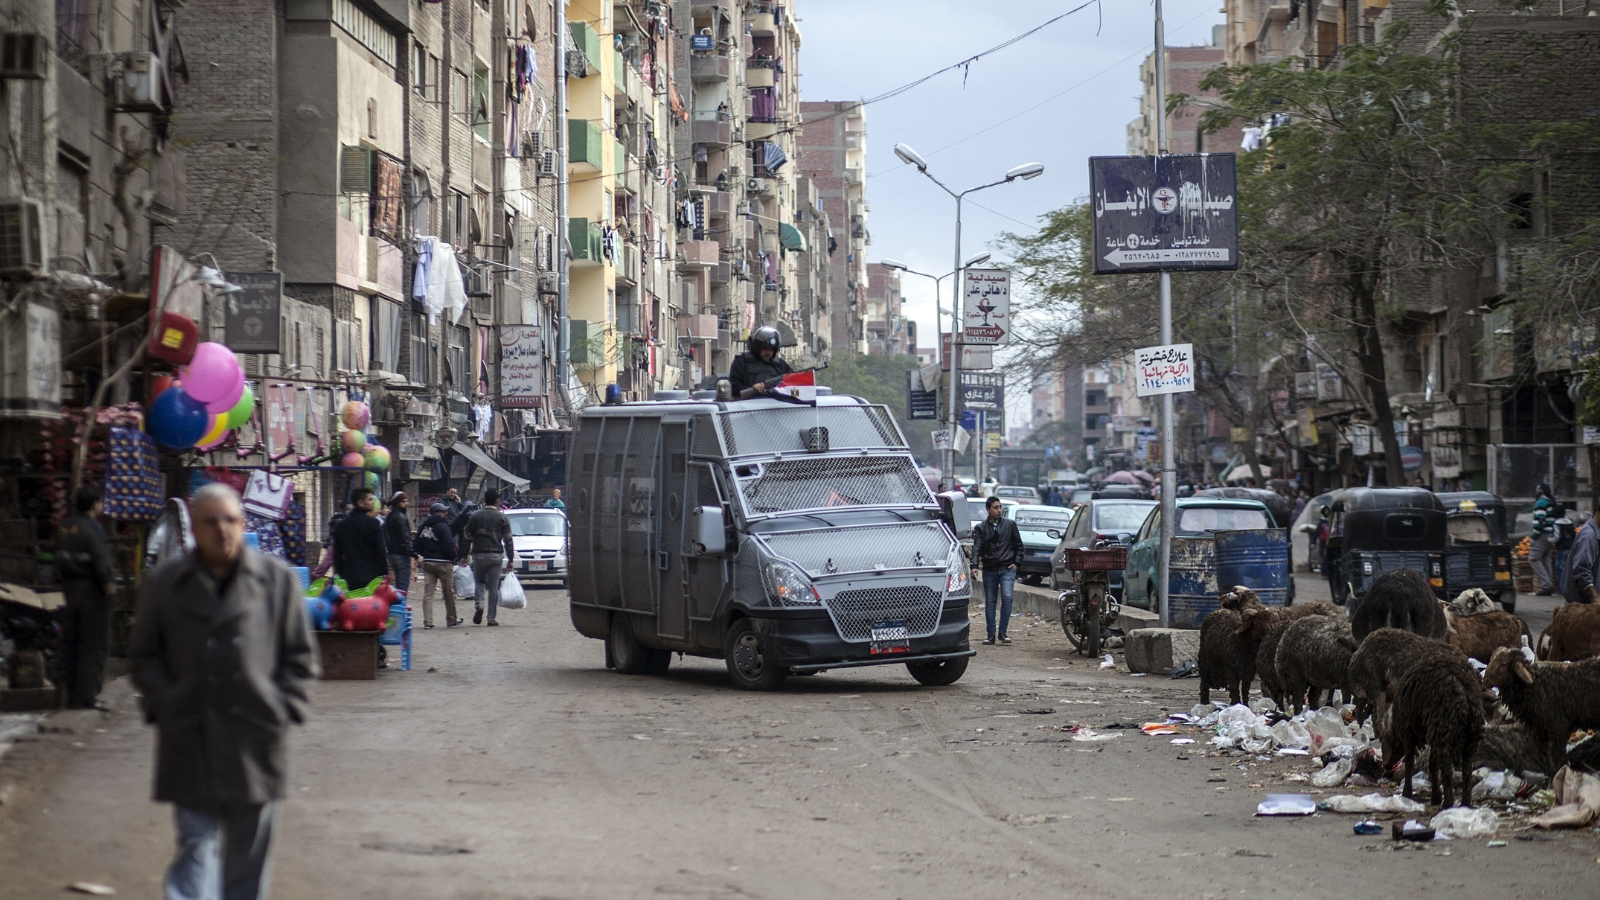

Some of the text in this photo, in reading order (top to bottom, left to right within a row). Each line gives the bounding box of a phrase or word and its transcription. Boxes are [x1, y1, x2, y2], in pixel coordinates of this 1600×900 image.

[1106, 236, 1126, 248] ساعة
[1140, 235, 1161, 247] خدمة
[1170, 236, 1192, 248] توصيل
[1192, 234, 1210, 246] خدمة
[966, 272, 1007, 284] صيدلية
[521, 330, 539, 339] دكتورة
[1139, 348, 1188, 367] علاج خشونة
[1169, 362, 1189, 377] الركبة
